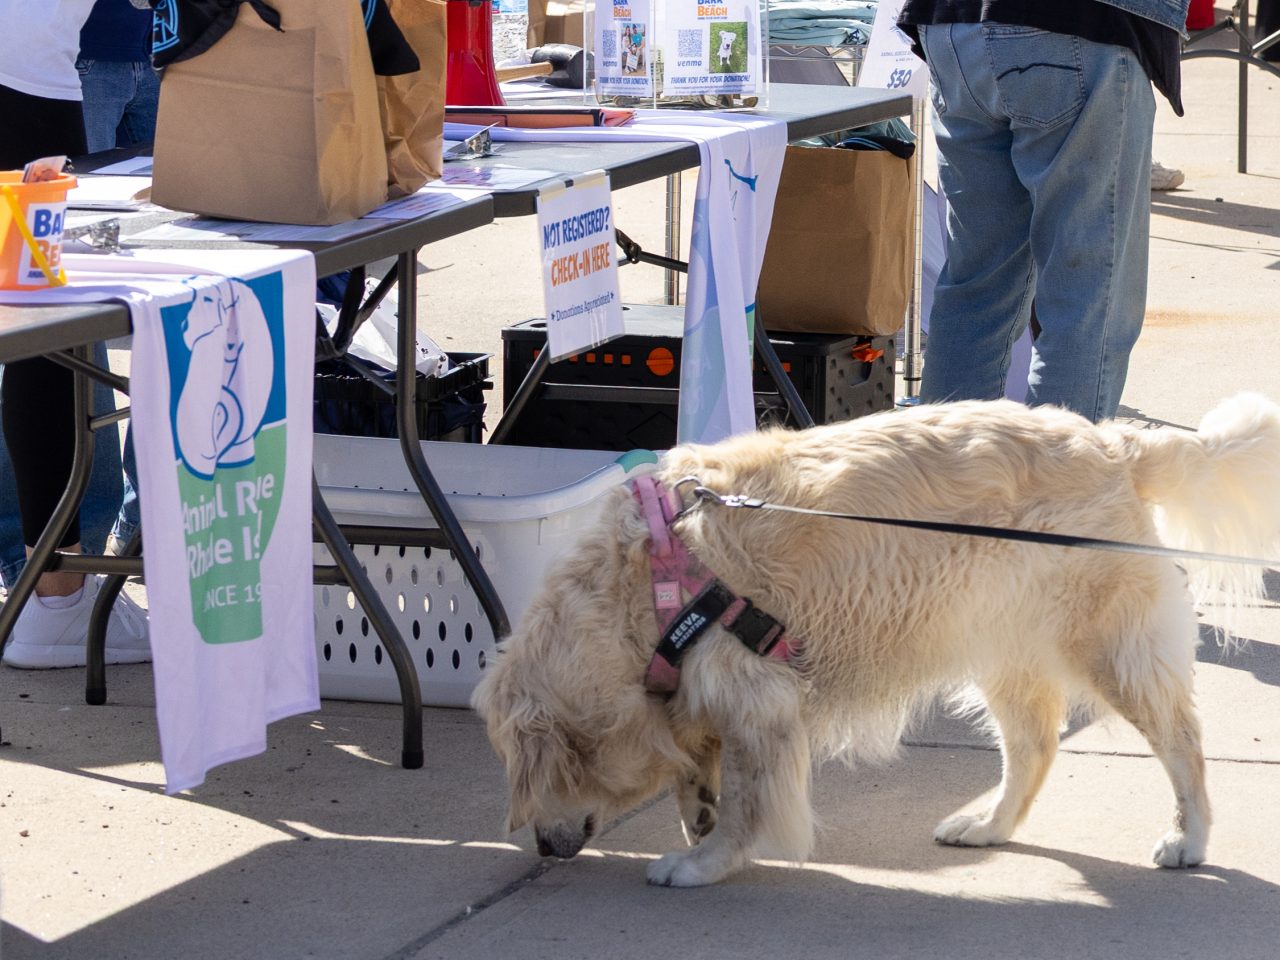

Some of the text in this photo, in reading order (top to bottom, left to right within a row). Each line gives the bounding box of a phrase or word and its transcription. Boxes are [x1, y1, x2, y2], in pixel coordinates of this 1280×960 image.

[613, 7, 632, 18] BEACH
[697, 6, 728, 17] BEACH
[677, 59, 702, 67] venmo
[687, 76, 698, 84] YOU
[710, 75, 723, 83] YOUR
[723, 74, 751, 83] DONATION!
[543, 206, 610, 250] NOT REGISTERED?
[551, 241, 610, 288] CHECK-IN HERE
[556, 291, 611, 322] Donations Appreciated
[669, 612, 700, 644] KEEVA
